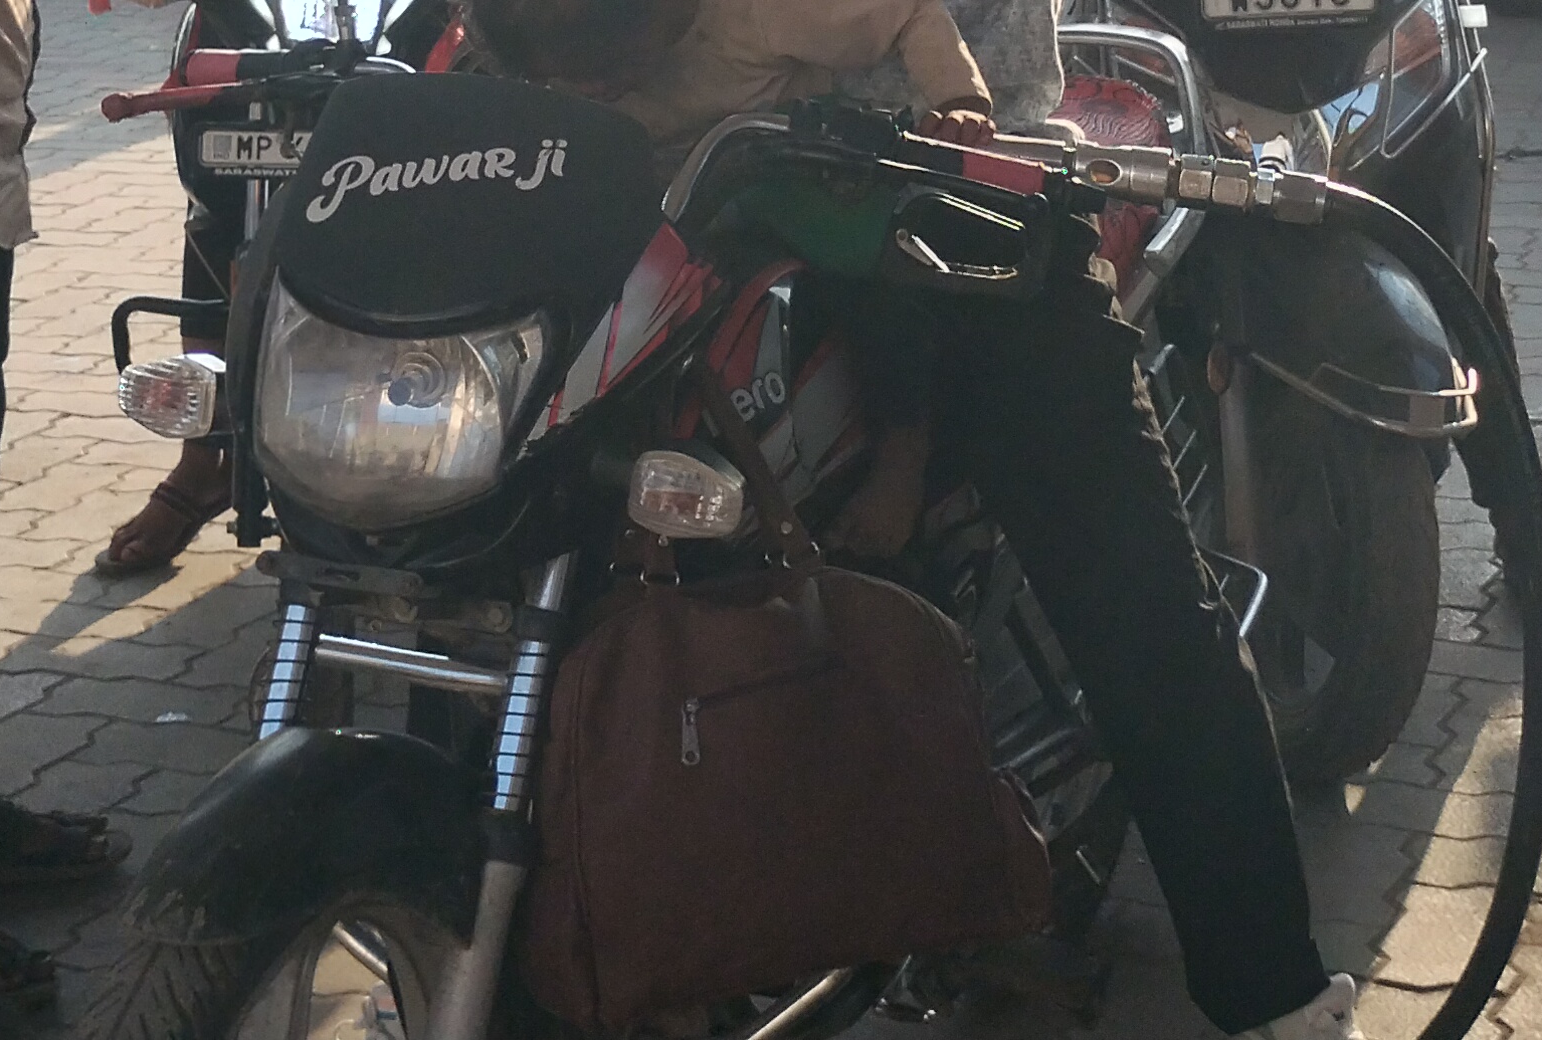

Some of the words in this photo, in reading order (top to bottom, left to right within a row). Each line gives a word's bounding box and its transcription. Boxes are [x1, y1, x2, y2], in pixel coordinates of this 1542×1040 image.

[237, 135, 272, 159] MP
[515, 139, 568, 191] ji
[727, 371, 787, 424] ero
